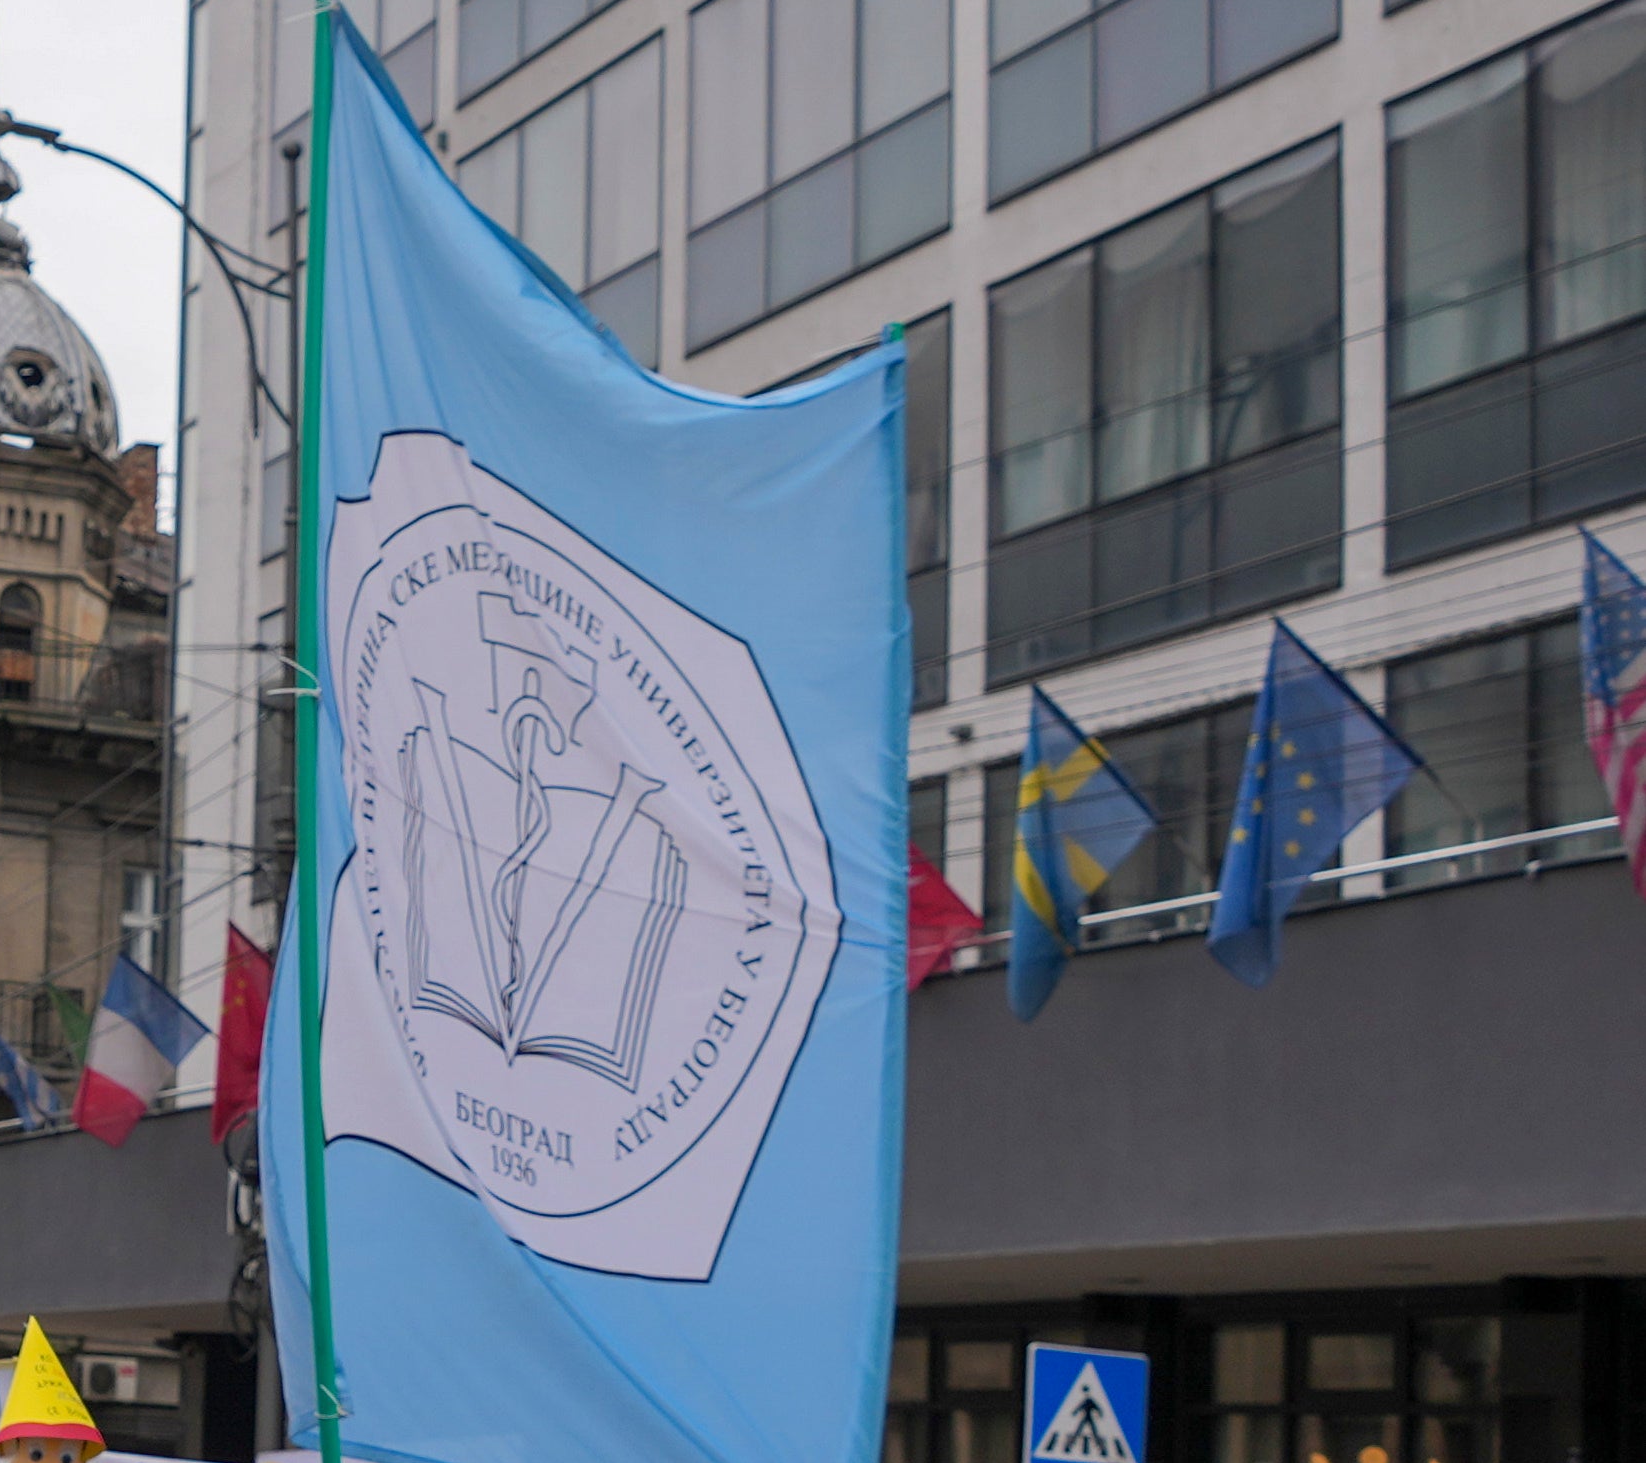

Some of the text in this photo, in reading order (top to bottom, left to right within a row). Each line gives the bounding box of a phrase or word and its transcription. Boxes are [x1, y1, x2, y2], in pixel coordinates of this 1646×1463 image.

[614, 985, 750, 1163] БЕОГРАДУ
[455, 1090, 575, 1169] БЕОГРАД
[489, 1143, 538, 1188] 1936
